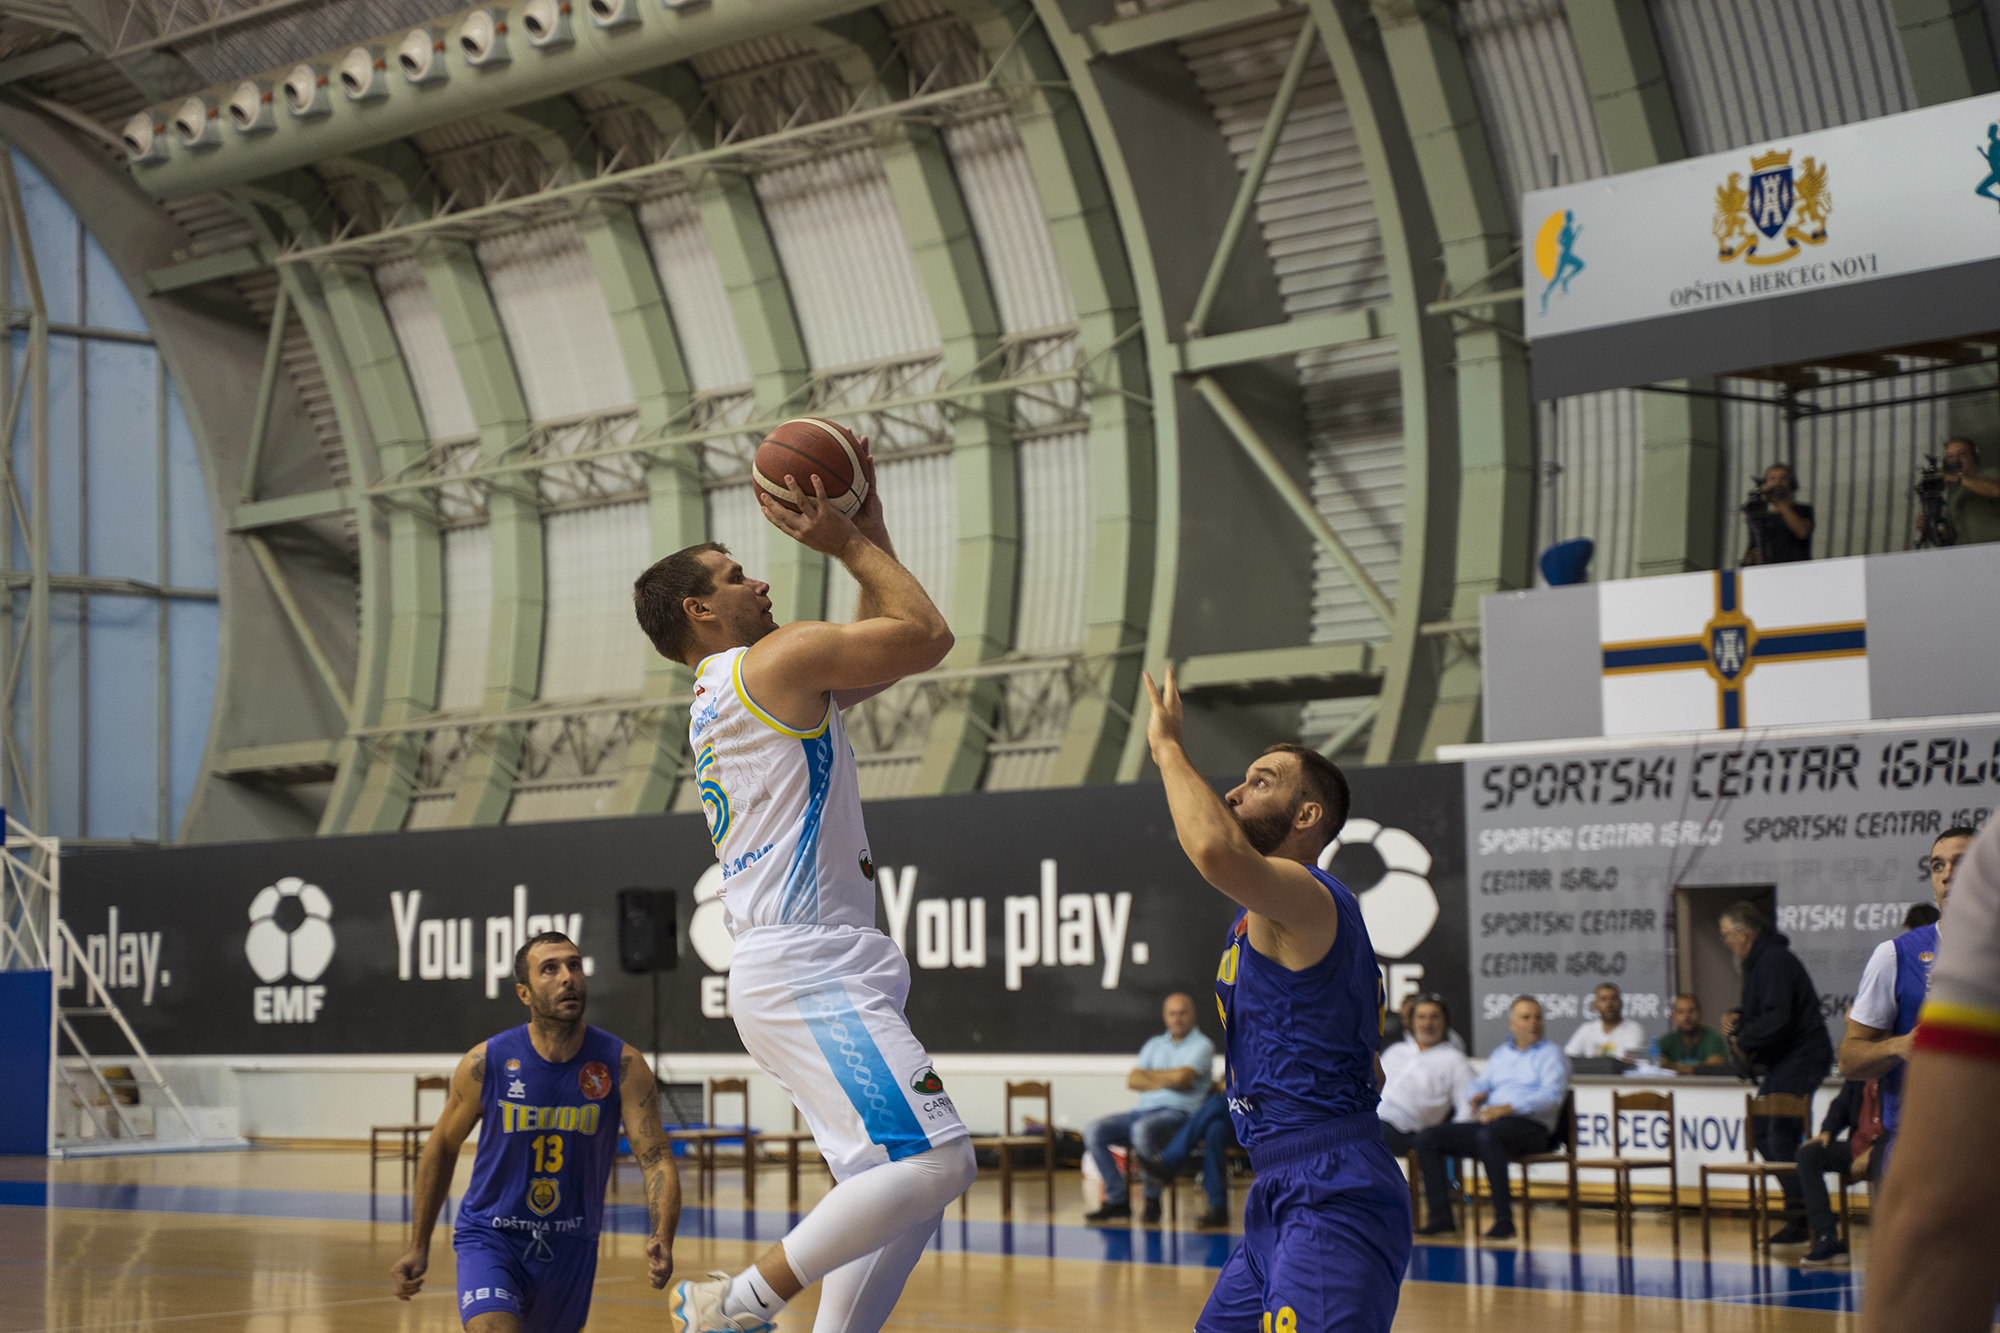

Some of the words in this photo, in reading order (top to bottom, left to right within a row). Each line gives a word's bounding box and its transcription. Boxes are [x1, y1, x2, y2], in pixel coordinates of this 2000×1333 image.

[1670, 281, 1745, 307] OPŠTINA
[1750, 262, 1826, 294] HERCEG
[1830, 252, 1878, 280] NOVI
[1483, 756, 1676, 811] SPORTSKI
[1692, 743, 1860, 798] CENTAR
[1479, 827, 1575, 855] SPORTSKI
[1577, 822, 1655, 850] CENTAR
[1743, 814, 1848, 845] SPORTSKI
[1855, 808, 1942, 839] CENTAR
[1951, 807, 1995, 831] IGA
[1481, 868, 1553, 896] CENTAR
[1560, 866, 1619, 892] IGALO
[389, 889, 473, 981] You
[877, 865, 986, 969] You
[1004, 858, 1150, 991] play.
[1480, 911, 1575, 938] SPORTSKI
[1580, 908, 1656, 935] CENTAR
[86, 905, 171, 1007] play.
[1481, 951, 1558, 978] CENTAR
[1565, 951, 1628, 976] IGALO
[253, 985, 327, 1025] EMF
[498, 1100, 600, 1136] TEODO
[1575, 1114, 1670, 1149] ERCEG
[1681, 1116, 1747, 1151] NOV
[531, 1134, 564, 1174] 13
[492, 1216, 551, 1231] OPŠTINA
